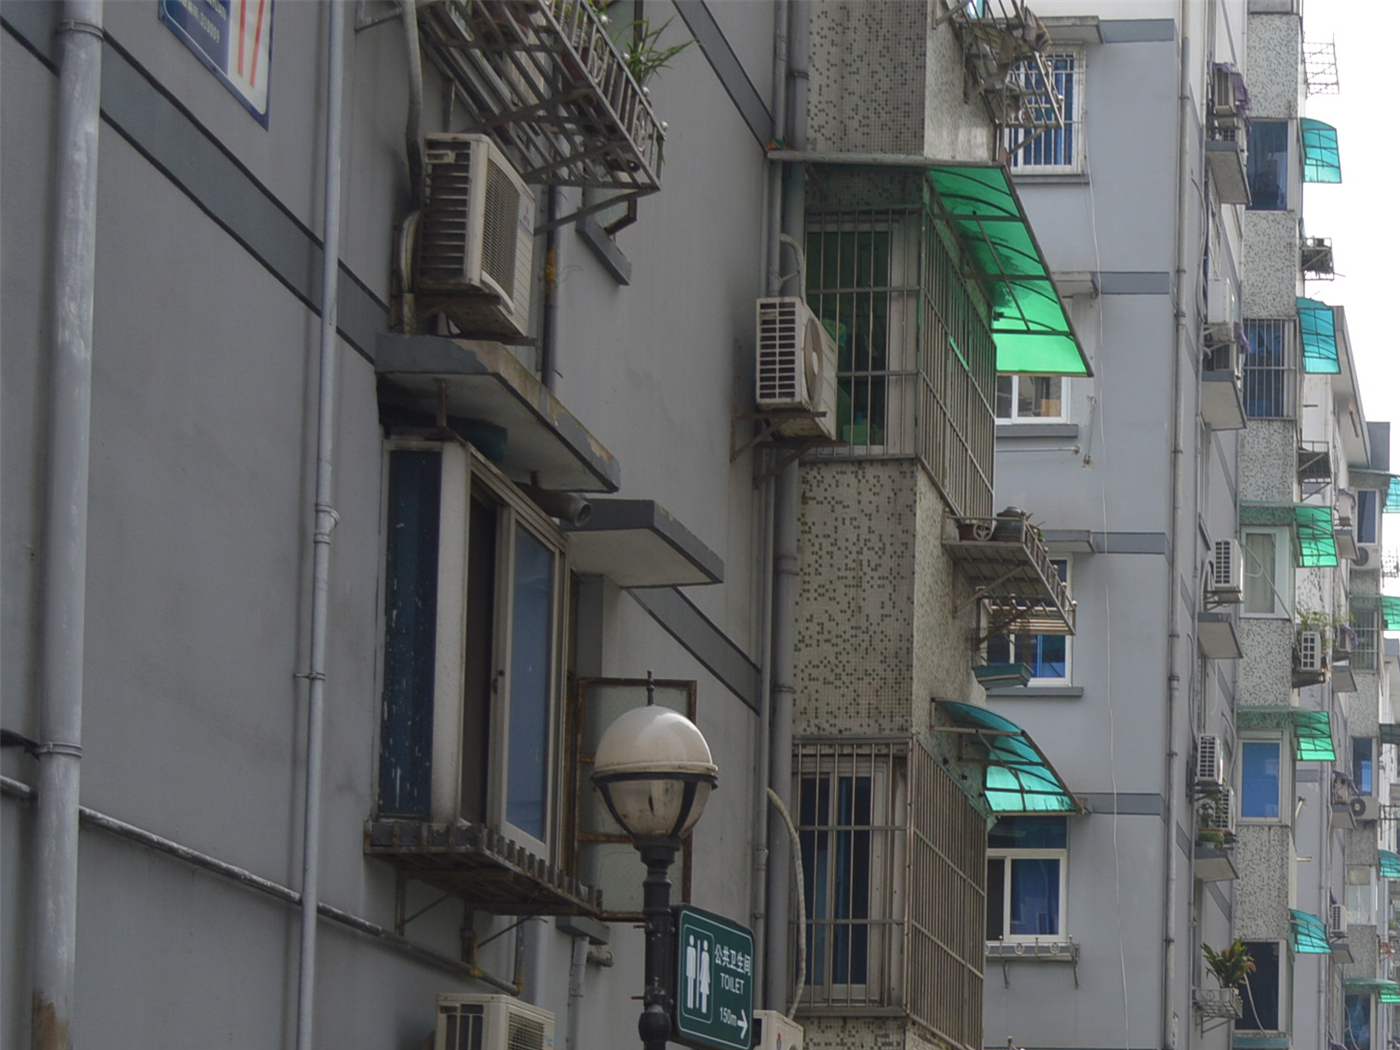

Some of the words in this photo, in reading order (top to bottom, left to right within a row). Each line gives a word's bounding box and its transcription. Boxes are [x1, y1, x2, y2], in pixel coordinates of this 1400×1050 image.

[714, 944, 751, 976] 公共卫生间
[720, 973, 745, 995] TOILET
[719, 1006, 737, 1027] 150m
